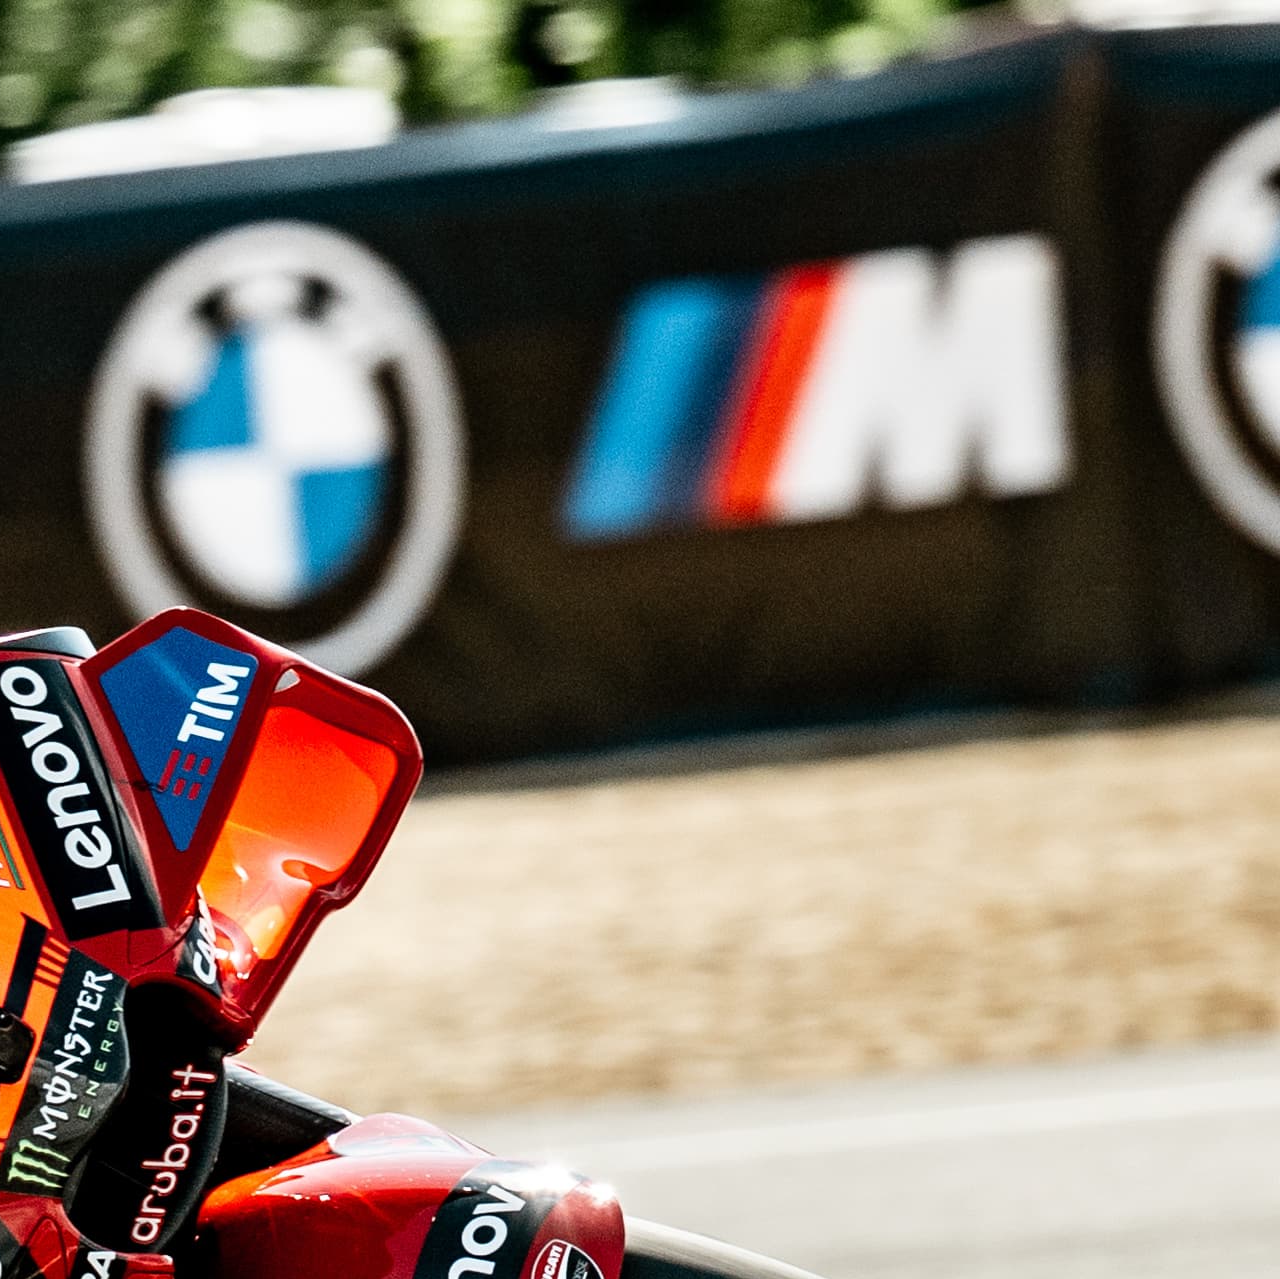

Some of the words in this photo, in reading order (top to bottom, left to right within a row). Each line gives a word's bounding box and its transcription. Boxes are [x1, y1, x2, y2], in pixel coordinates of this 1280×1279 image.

[0, 664, 132, 912] Lenovo
[176, 660, 251, 748] TIM
[32, 968, 113, 1141] MONSTER
[77, 1003, 125, 1119] ENERGY
[130, 1063, 217, 1244] aruba.it
